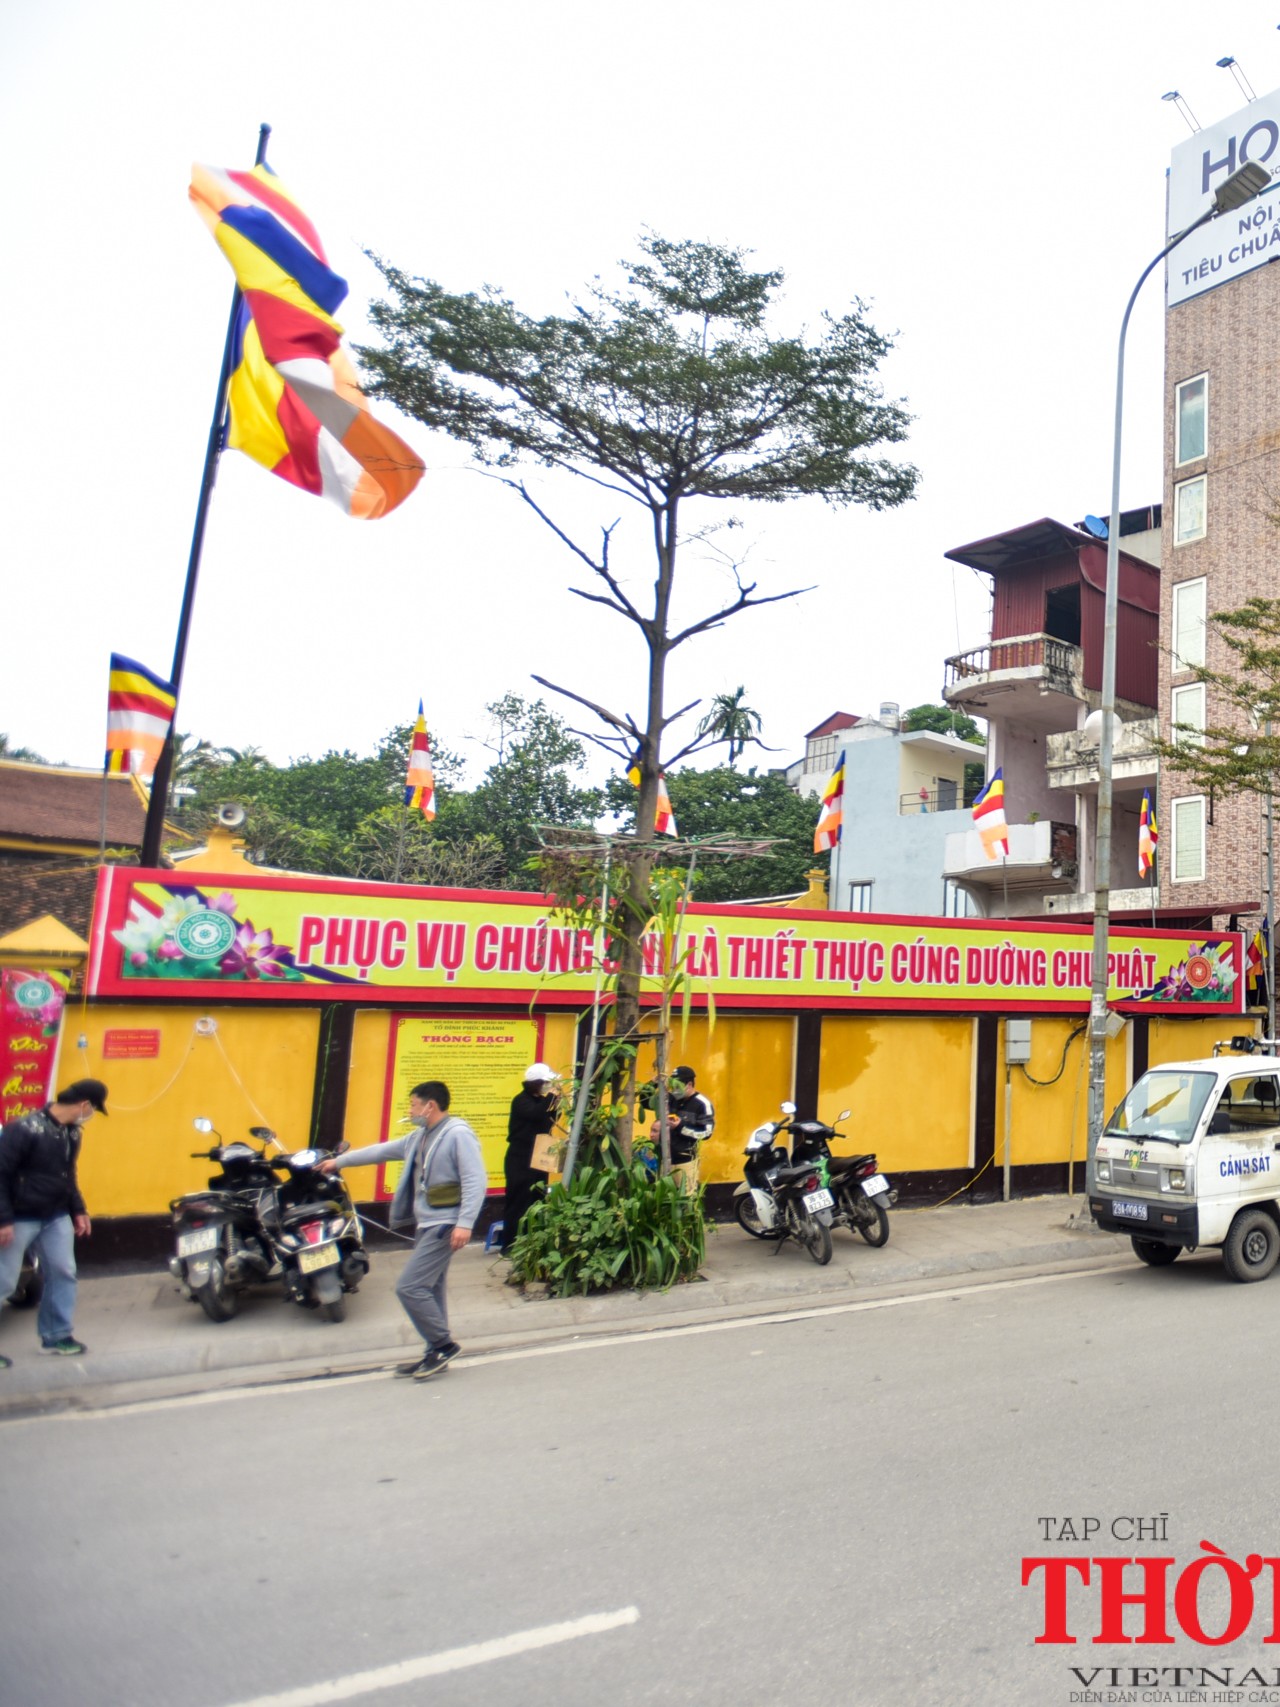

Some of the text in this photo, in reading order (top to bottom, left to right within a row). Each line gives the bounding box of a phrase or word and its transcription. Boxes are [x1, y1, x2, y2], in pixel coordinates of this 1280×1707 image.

[1238, 206, 1273, 235] NỘI
[1182, 254, 1223, 286] TIÊU
[296, 915, 407, 979] PHỤC
[417, 920, 466, 981] VỤ
[474, 917, 593, 975] CHÚNG
[602, 932, 677, 976] SNH
[686, 925, 721, 979] LÀ
[728, 928, 807, 980] THIẾT
[813, 940, 884, 991] THỰC
[891, 937, 959, 985] CÚNG
[966, 939, 1046, 987] DƯỜNG
[1106, 948, 1157, 998] PHẬT
[421, 1034, 514, 1045] THÔNG BẠCH
[1124, 1149, 1149, 1160] PCE
[1251, 1153, 1270, 1174] SÁT
